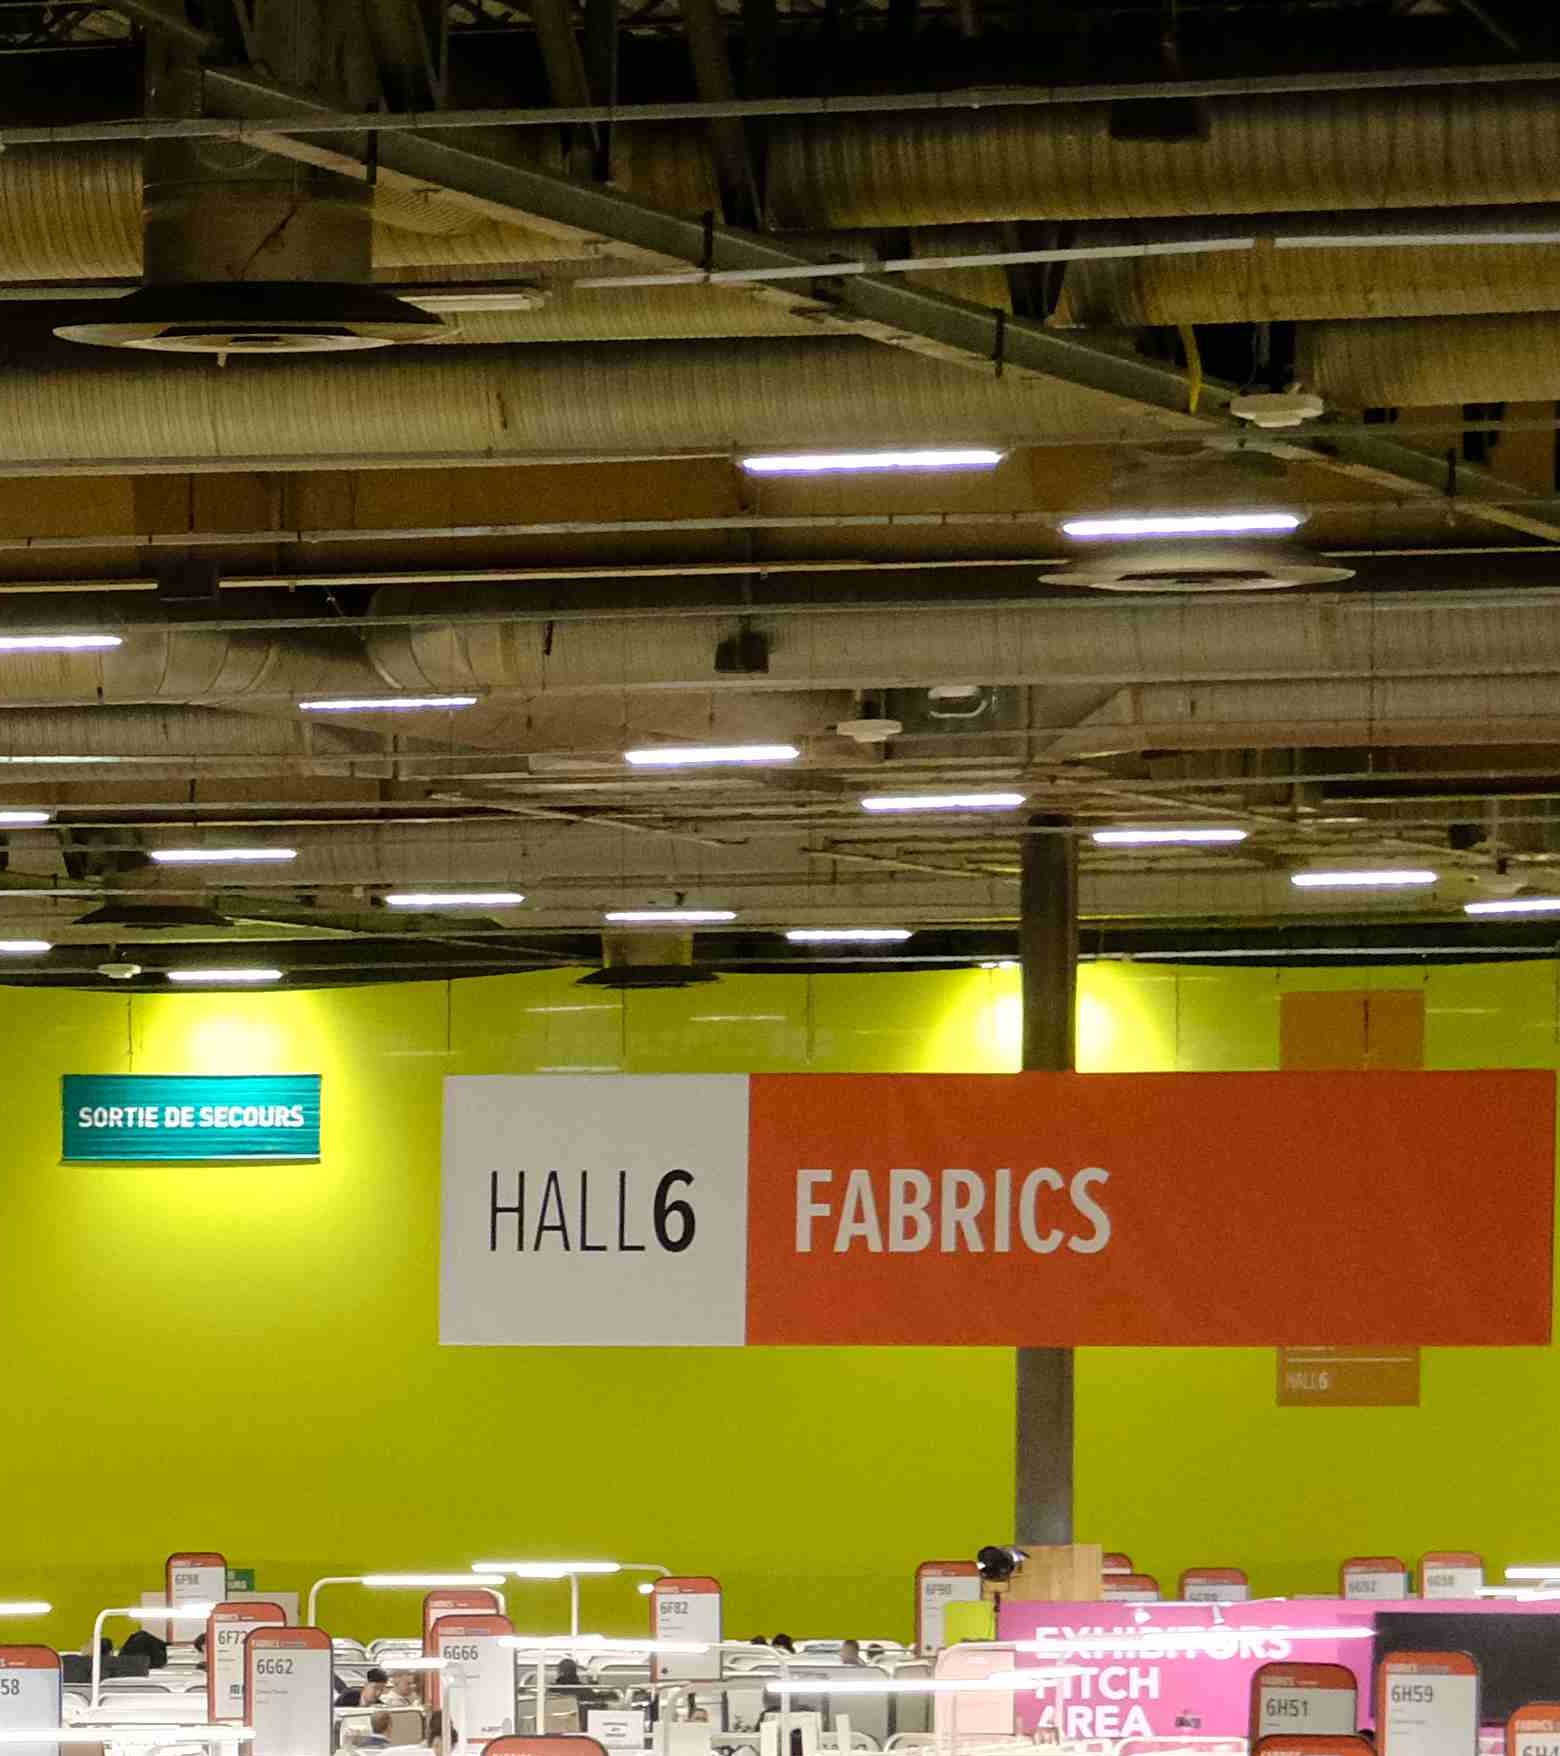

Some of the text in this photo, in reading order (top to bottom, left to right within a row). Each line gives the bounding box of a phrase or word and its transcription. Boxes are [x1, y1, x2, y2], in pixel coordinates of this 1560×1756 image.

[78, 1105, 305, 1129] SORTIE DE SECOURS
[794, 1167, 1113, 1256] FABRICS
[442, 1645, 479, 1661] 6G66
[256, 1658, 294, 1674] 6G62
[1391, 1684, 1434, 1703] 6H59
[1265, 1699, 1309, 1718] 6H51
[1036, 1706, 1153, 1738] AREA
